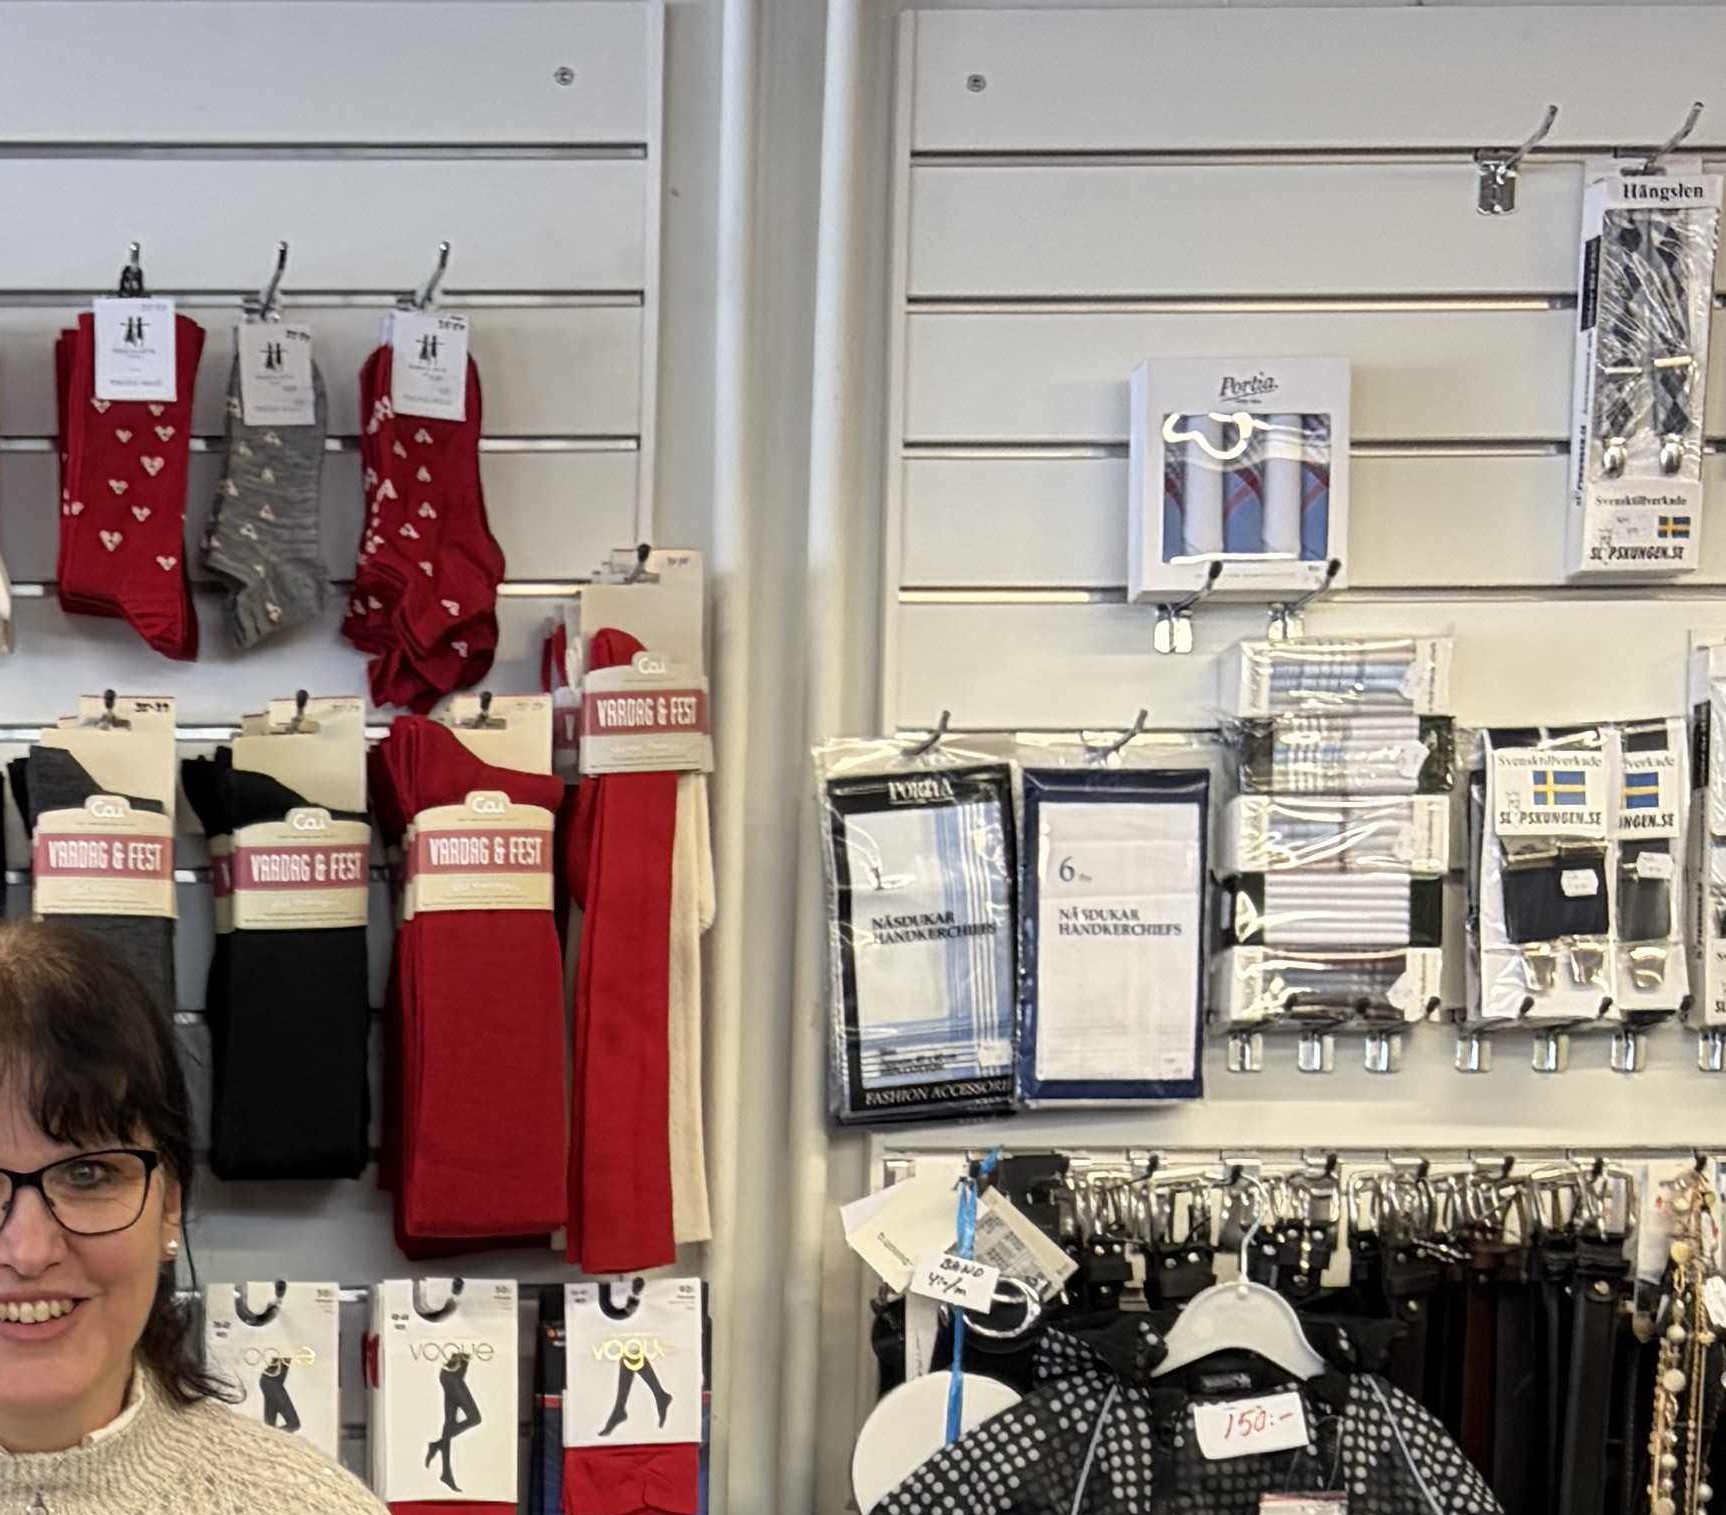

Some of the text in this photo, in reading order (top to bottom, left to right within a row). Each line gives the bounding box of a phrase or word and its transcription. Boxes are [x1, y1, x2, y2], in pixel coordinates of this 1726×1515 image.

[1623, 183, 1704, 200] Hängslen
[596, 696, 654, 728] VARDAG
[670, 696, 698, 726] FEST
[48, 840, 109, 870] VARDAG
[127, 842, 163, 872] FEST
[428, 837, 491, 866] VARDAG
[508, 837, 542, 866] FEST
[250, 854, 311, 883] VARDAG
[330, 852, 362, 881] FEST
[1059, 855, 1075, 883] 6
[873, 923, 997, 945] HANDKERCHIEFS
[1058, 923, 1182, 936] HANDKERCHIEFS
[865, 1086, 929, 1106] FASHION
[409, 1342, 495, 1372] vogue
[1224, 1405, 1293, 1440] 150:-
